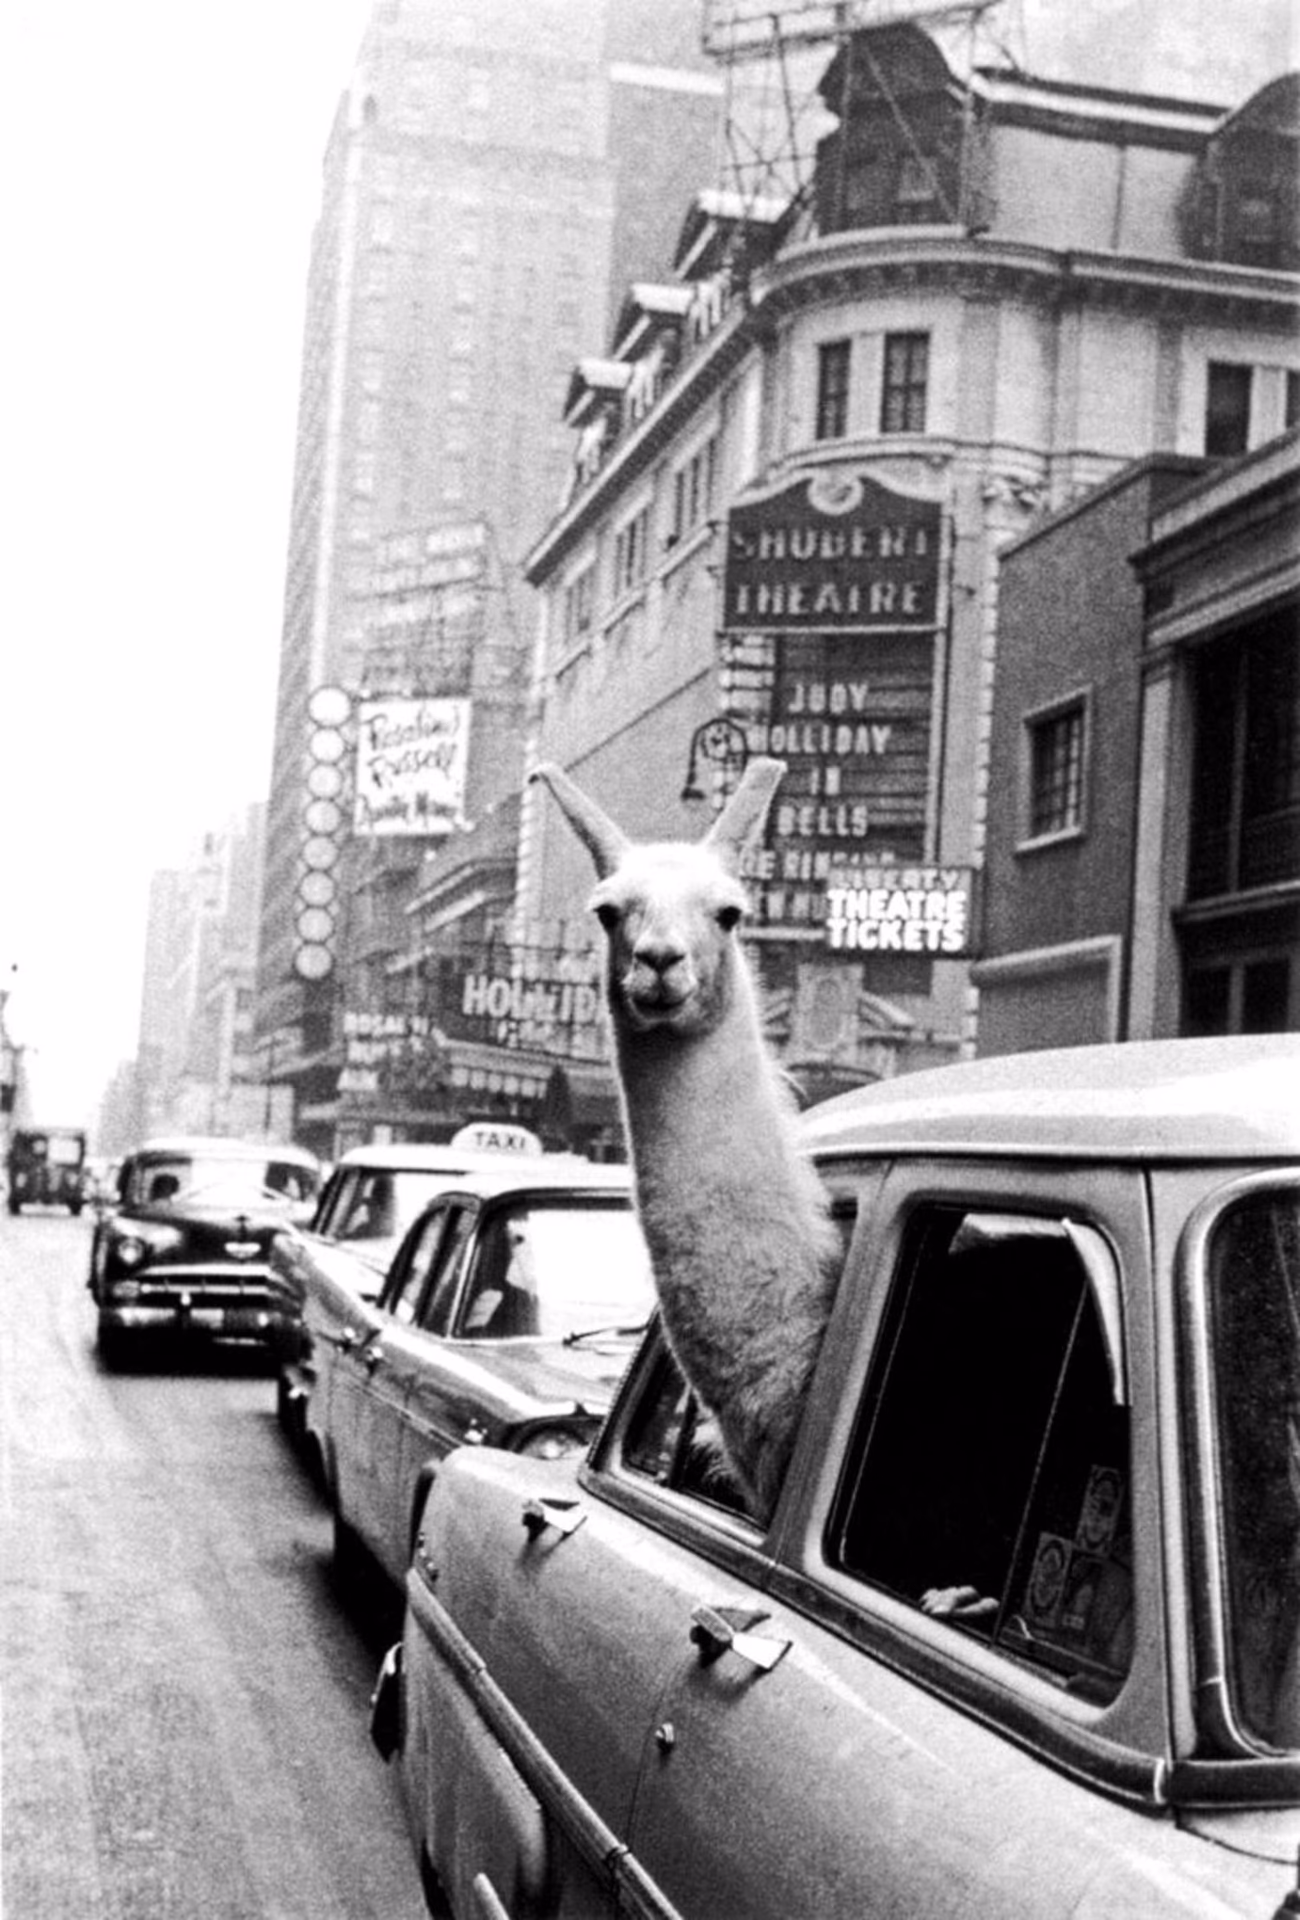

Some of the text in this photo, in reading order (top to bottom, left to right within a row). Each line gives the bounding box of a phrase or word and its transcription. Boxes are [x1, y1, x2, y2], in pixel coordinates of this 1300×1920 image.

[736, 581, 921, 615] THEATRE
[788, 683, 868, 714] JUDY
[777, 805, 869, 837] BELLS
[828, 889, 967, 921] THEATRE
[827, 918, 966, 951] TICKETS
[475, 1131, 526, 1150] TAXI
